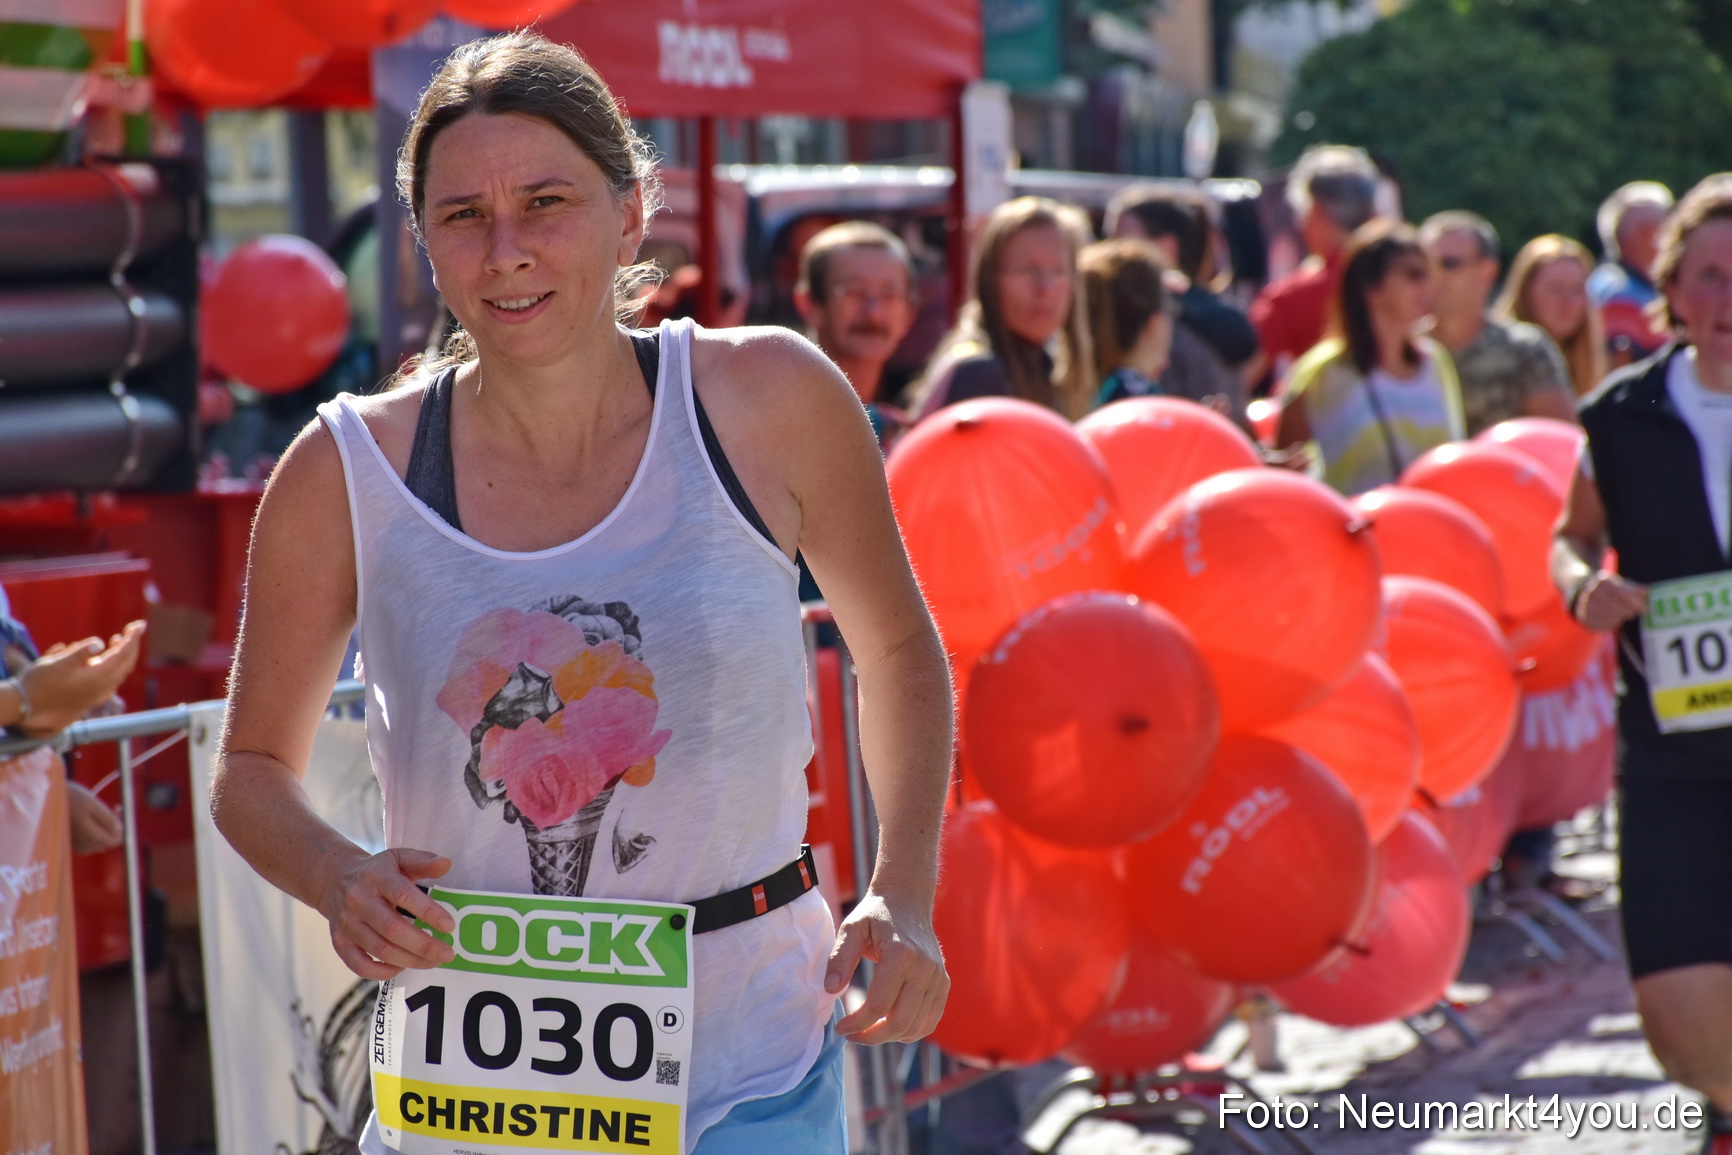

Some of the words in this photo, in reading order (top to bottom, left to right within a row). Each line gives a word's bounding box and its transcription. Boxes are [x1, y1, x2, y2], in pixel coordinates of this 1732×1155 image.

[1667, 628, 1732, 679] 10
[404, 984, 655, 1082] 1030
[662, 1012, 678, 1028] D
[399, 1091, 652, 1147] CHRISTINE
